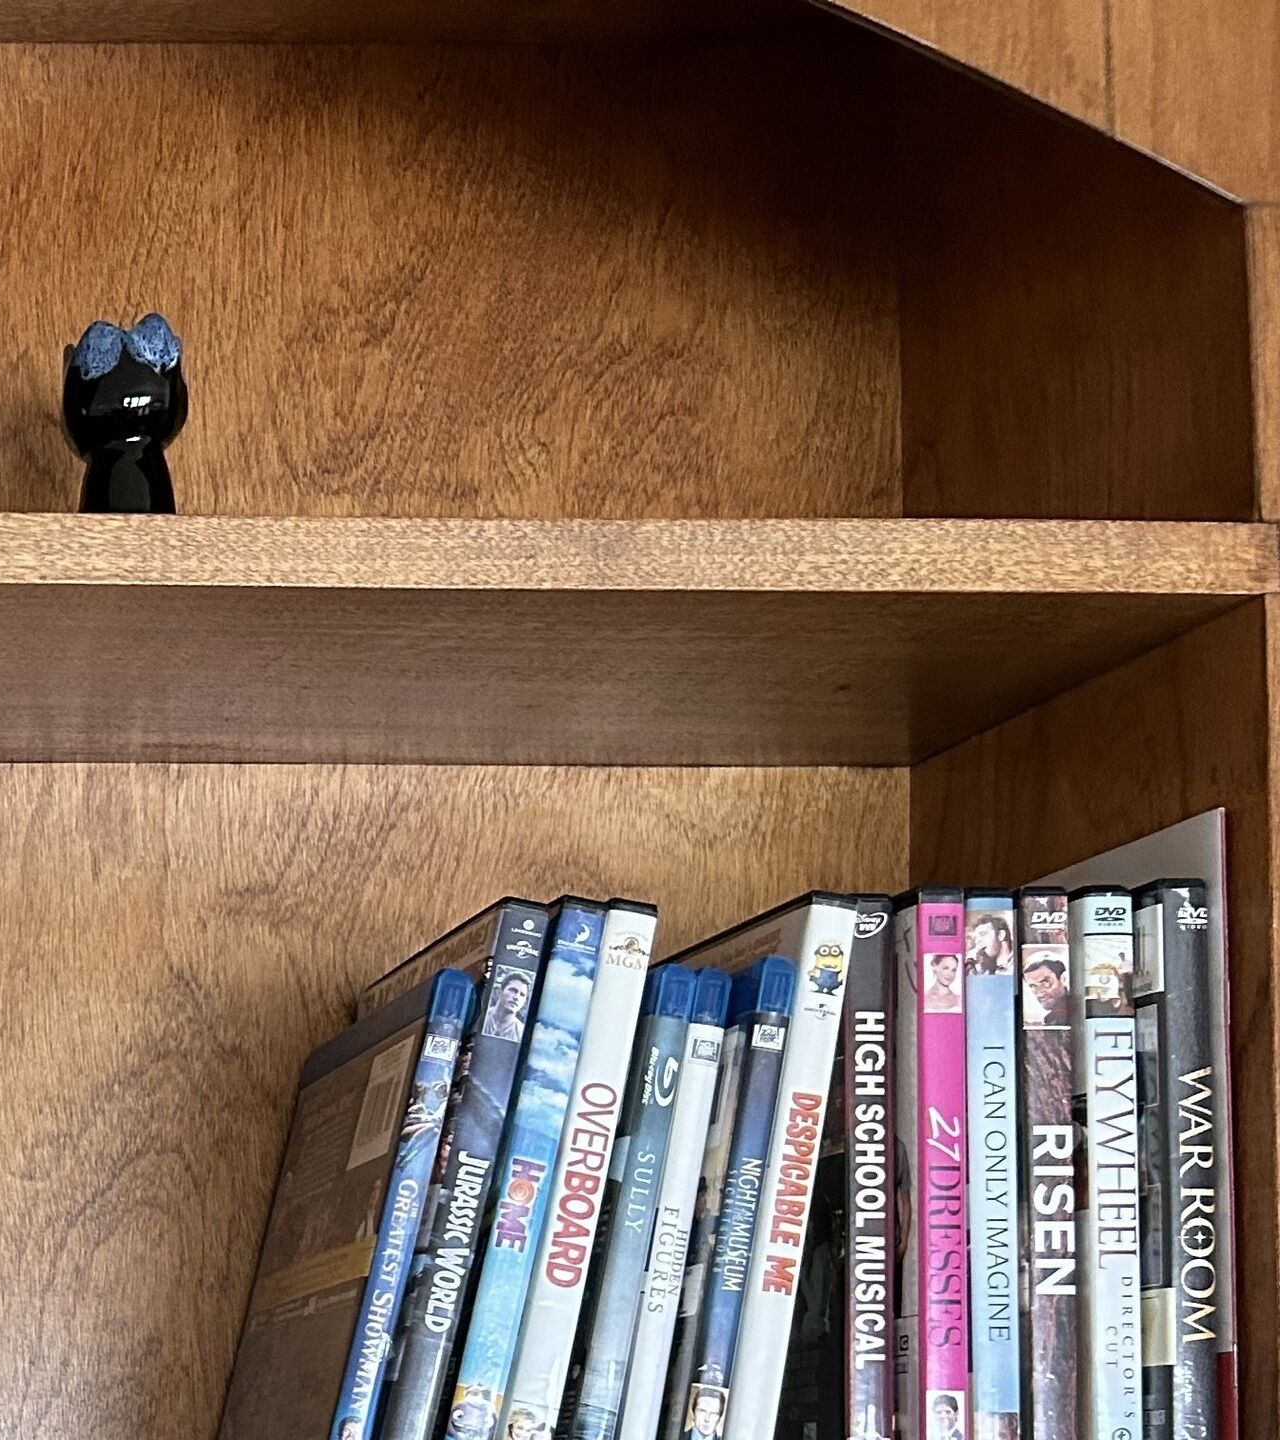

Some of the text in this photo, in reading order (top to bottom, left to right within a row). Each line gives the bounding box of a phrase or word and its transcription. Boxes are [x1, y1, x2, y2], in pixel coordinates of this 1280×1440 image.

[605, 953, 647, 971] MGM
[1031, 911, 1068, 923] DVD
[1094, 907, 1127, 917] DVD
[983, 1060, 1007, 1120] CAN
[1177, 1065, 1215, 1179] WAR
[545, 1082, 619, 1289] OVERBOARD
[624, 1150, 656, 1233] SULLY
[735, 1157, 763, 1210] NIGHT
[769, 1090, 823, 1248] DESPICABLE
[853, 1009, 887, 1370] HIGH SCHOOL MUSICAL
[984, 1129, 1009, 1209] ONLY
[1093, 1030, 1138, 1270] FLYWHEEL
[424, 1149, 491, 1334] JURASSIC WORLD
[494, 1157, 548, 1254] HOME
[647, 1204, 681, 1314] FIGURES
[720, 1221, 751, 1292] MUSEUM
[925, 1105, 962, 1348] 27 DRESSES
[1032, 1124, 1077, 1296] RISEN
[348, 1178, 419, 1412] GREATEST SHOWMAN
[667, 1228, 689, 1297] HIDDEN
[761, 1254, 797, 1297] ME
[986, 1218, 1011, 1342] IMAGINE
[1179, 1187, 1217, 1344] ROOM
[1105, 1325, 1119, 1369] CUT
[1121, 1275, 1135, 1419] DIRECTOR'S
